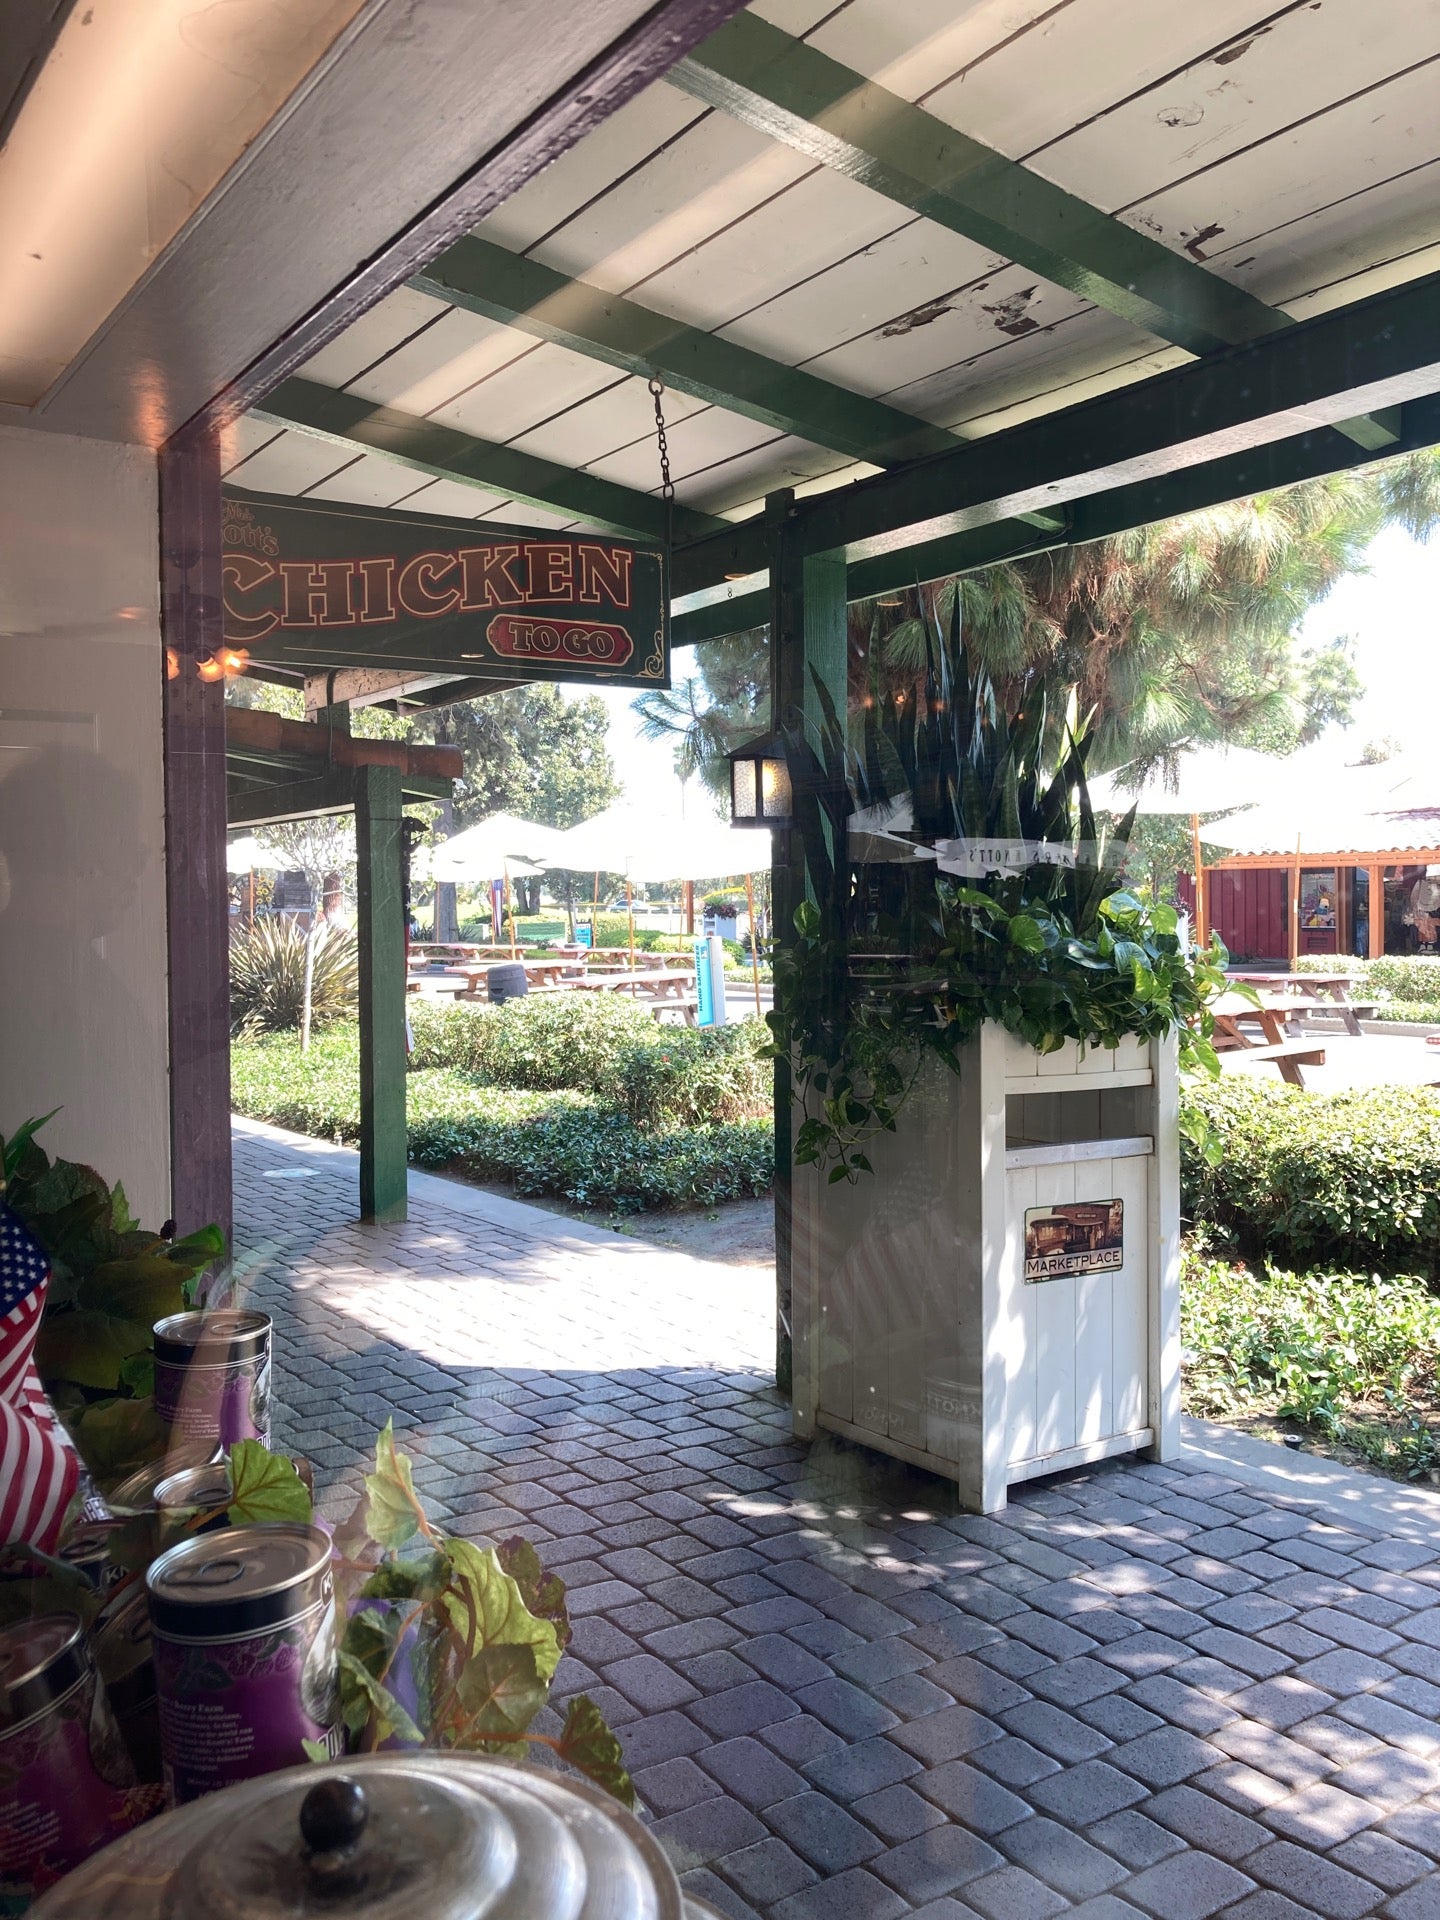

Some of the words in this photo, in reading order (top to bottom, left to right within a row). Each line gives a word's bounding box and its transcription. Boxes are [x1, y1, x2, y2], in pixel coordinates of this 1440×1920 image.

[222, 544, 632, 641] CHICKEN
[508, 621, 561, 654] TO
[562, 626, 615, 659] GO
[1027, 1251, 1120, 1274] MARKETPLACE
